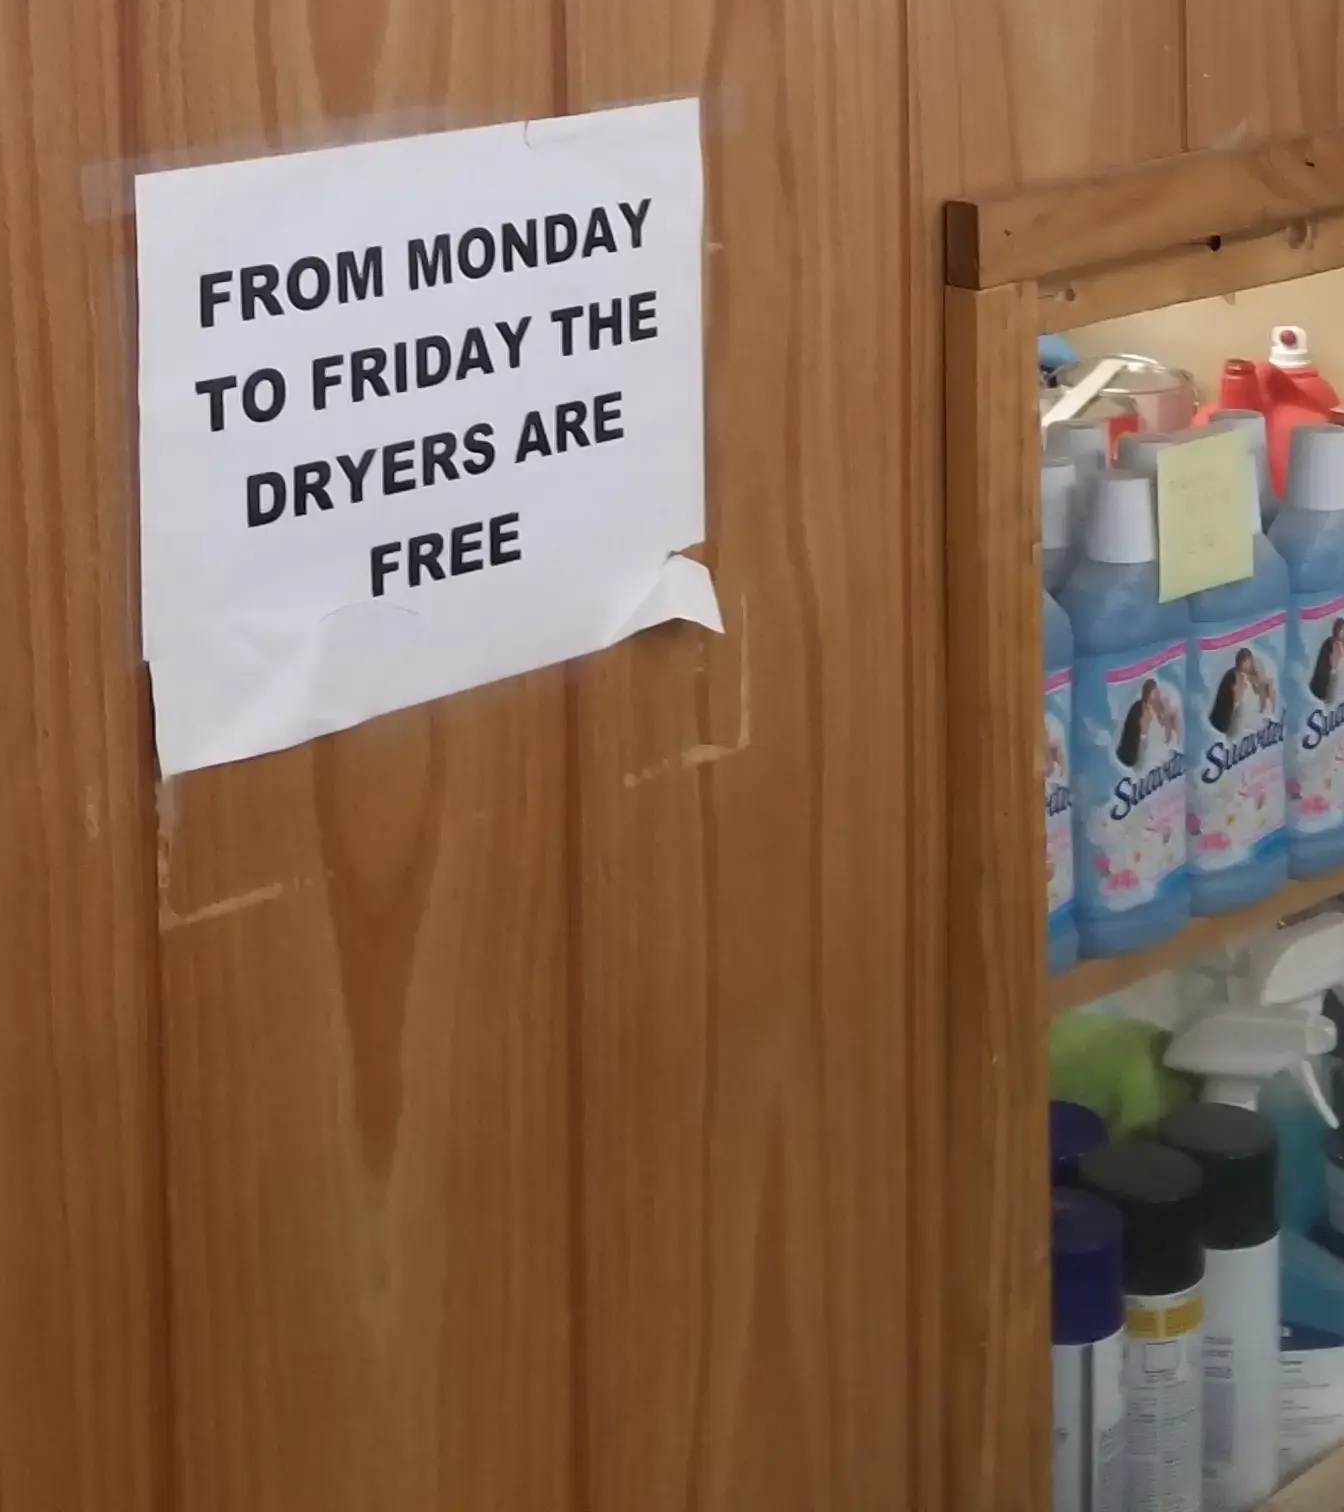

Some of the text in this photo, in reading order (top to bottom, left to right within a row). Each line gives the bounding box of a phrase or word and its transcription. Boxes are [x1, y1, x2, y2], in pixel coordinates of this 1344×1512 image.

[197, 198, 652, 328] FROM MONDAY
[196, 290, 659, 432] TO FRIDAY THE
[245, 391, 625, 528] DRYERS ARE
[370, 512, 523, 598] FREE
